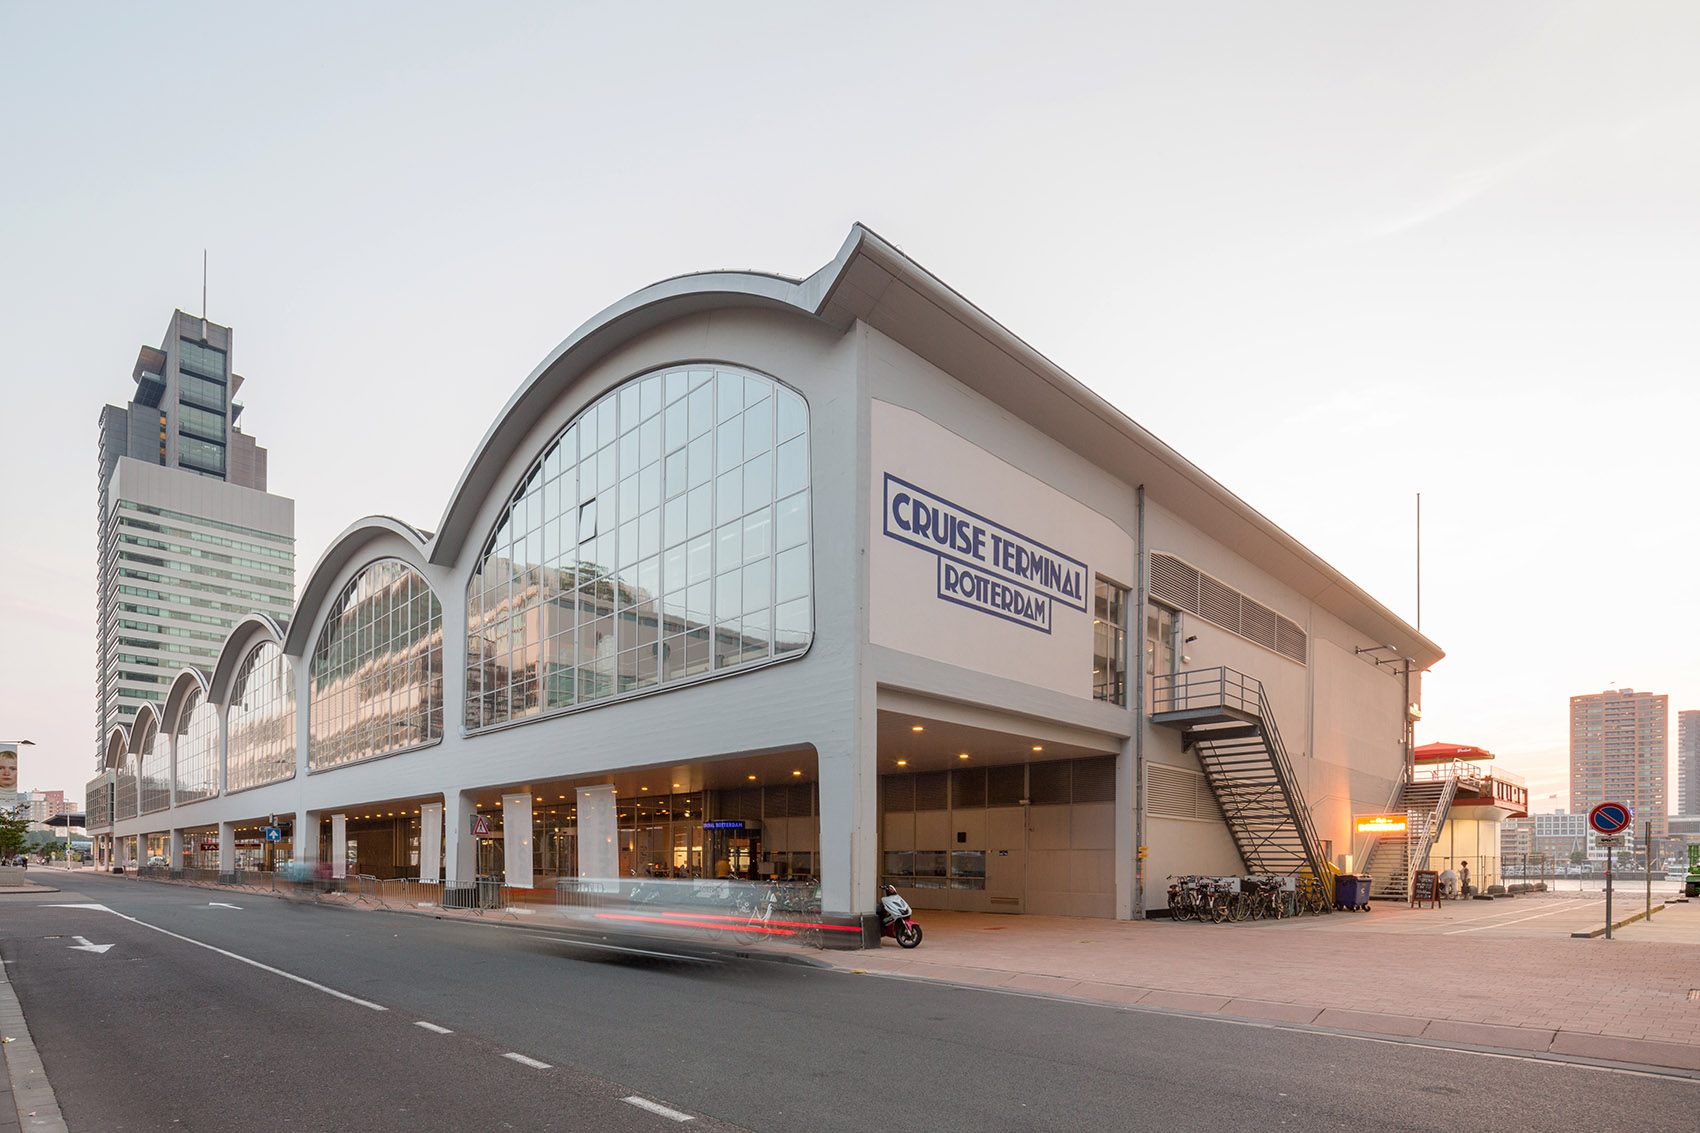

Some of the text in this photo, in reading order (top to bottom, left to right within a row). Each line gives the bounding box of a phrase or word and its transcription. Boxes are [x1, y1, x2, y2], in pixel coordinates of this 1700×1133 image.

[892, 492, 1082, 601] CRUISE TERMINAL
[944, 563, 1046, 624] ROTTERDAM
